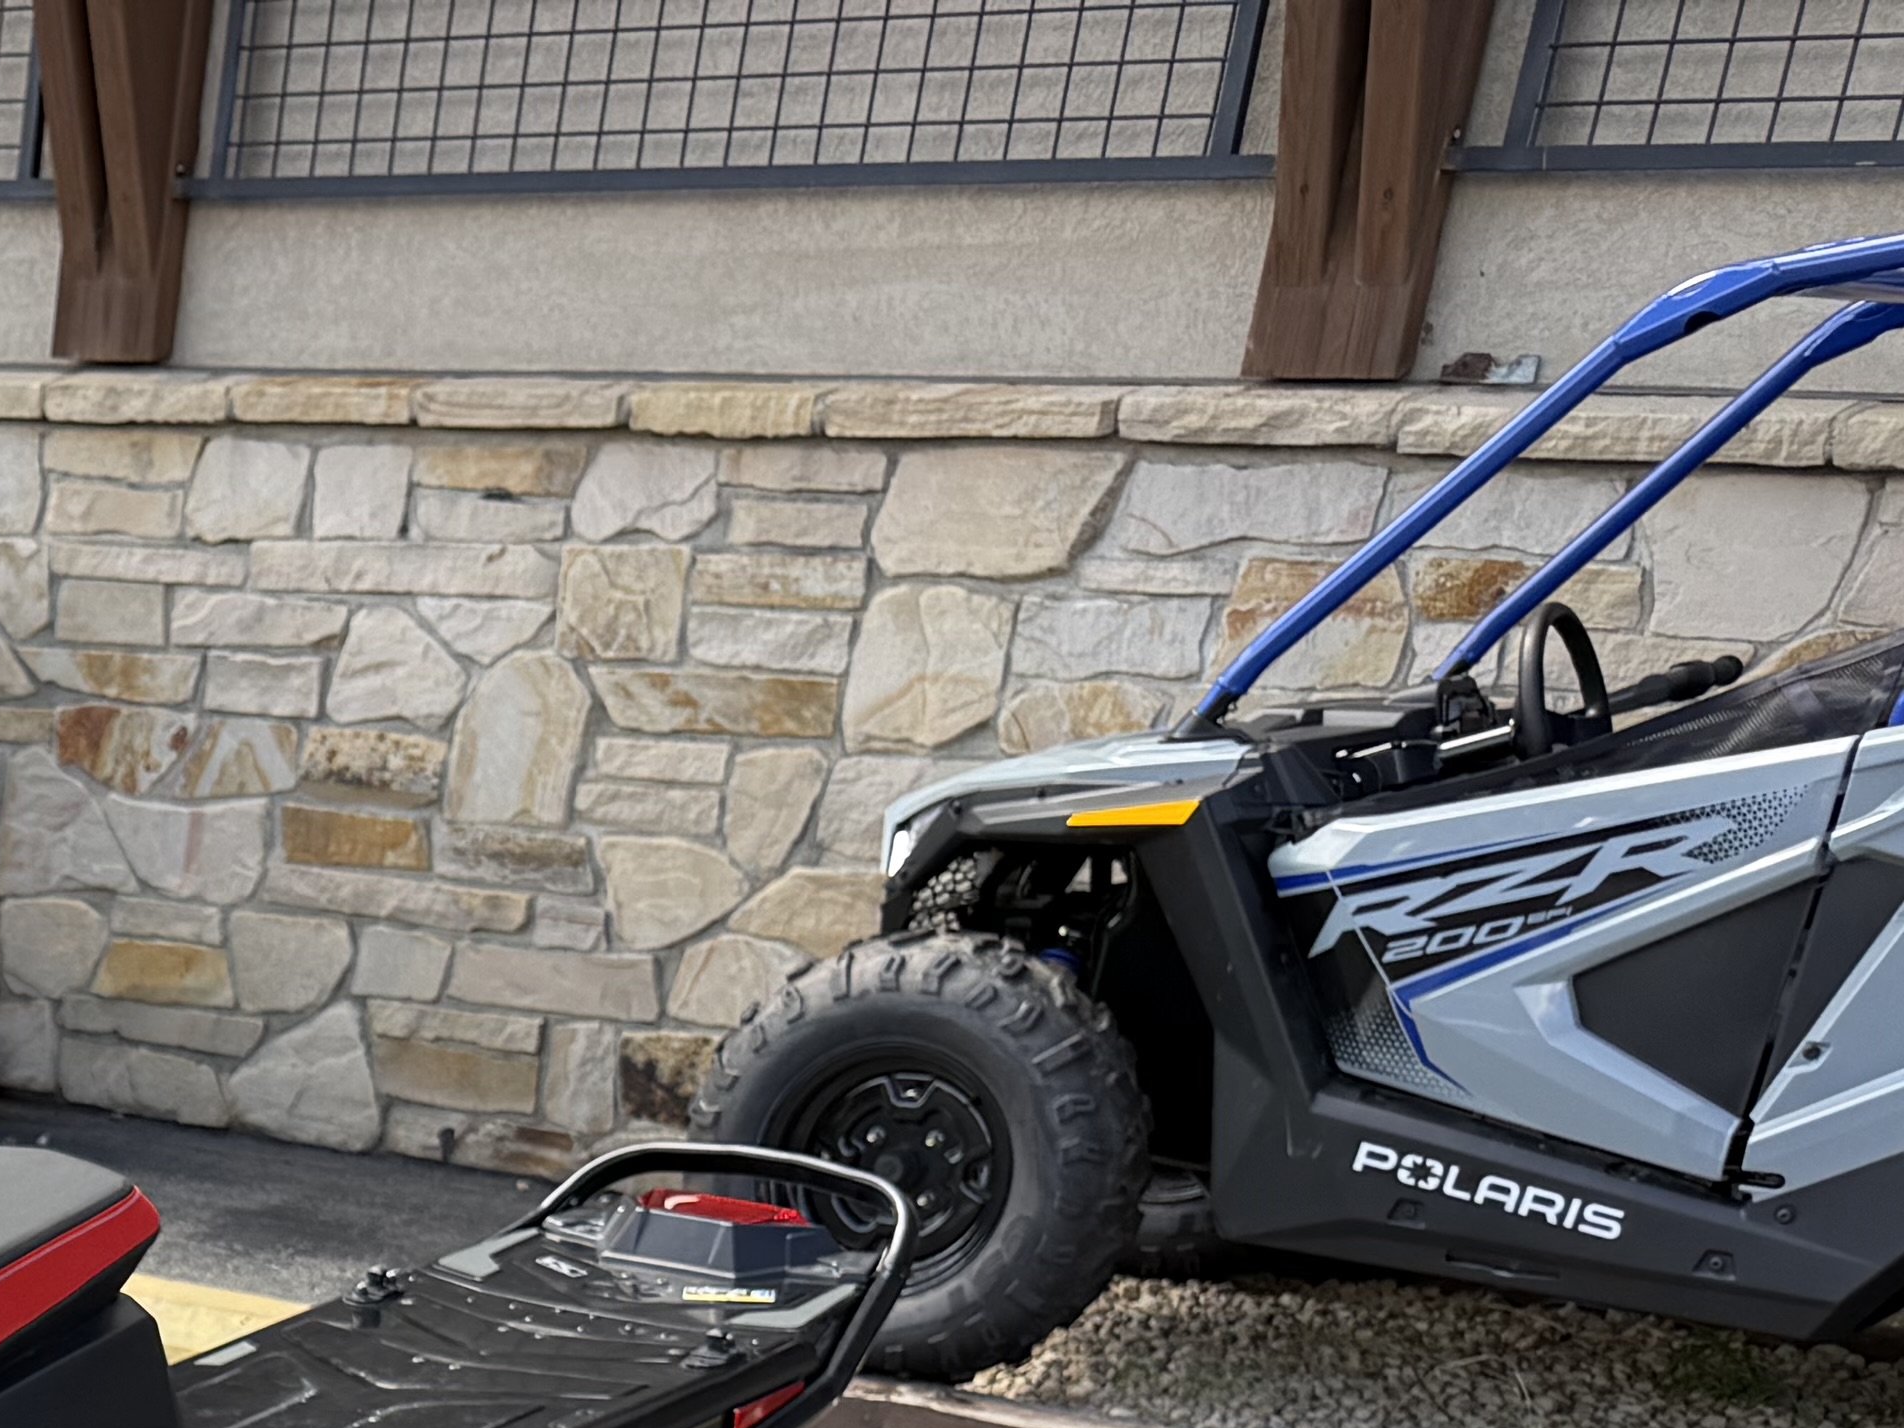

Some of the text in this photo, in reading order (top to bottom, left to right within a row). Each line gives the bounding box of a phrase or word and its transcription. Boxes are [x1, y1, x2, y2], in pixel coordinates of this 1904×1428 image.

[1308, 815, 1737, 959] RZR
[1381, 917, 1526, 964] 200
[1352, 1141, 1626, 1240] POLARIS
